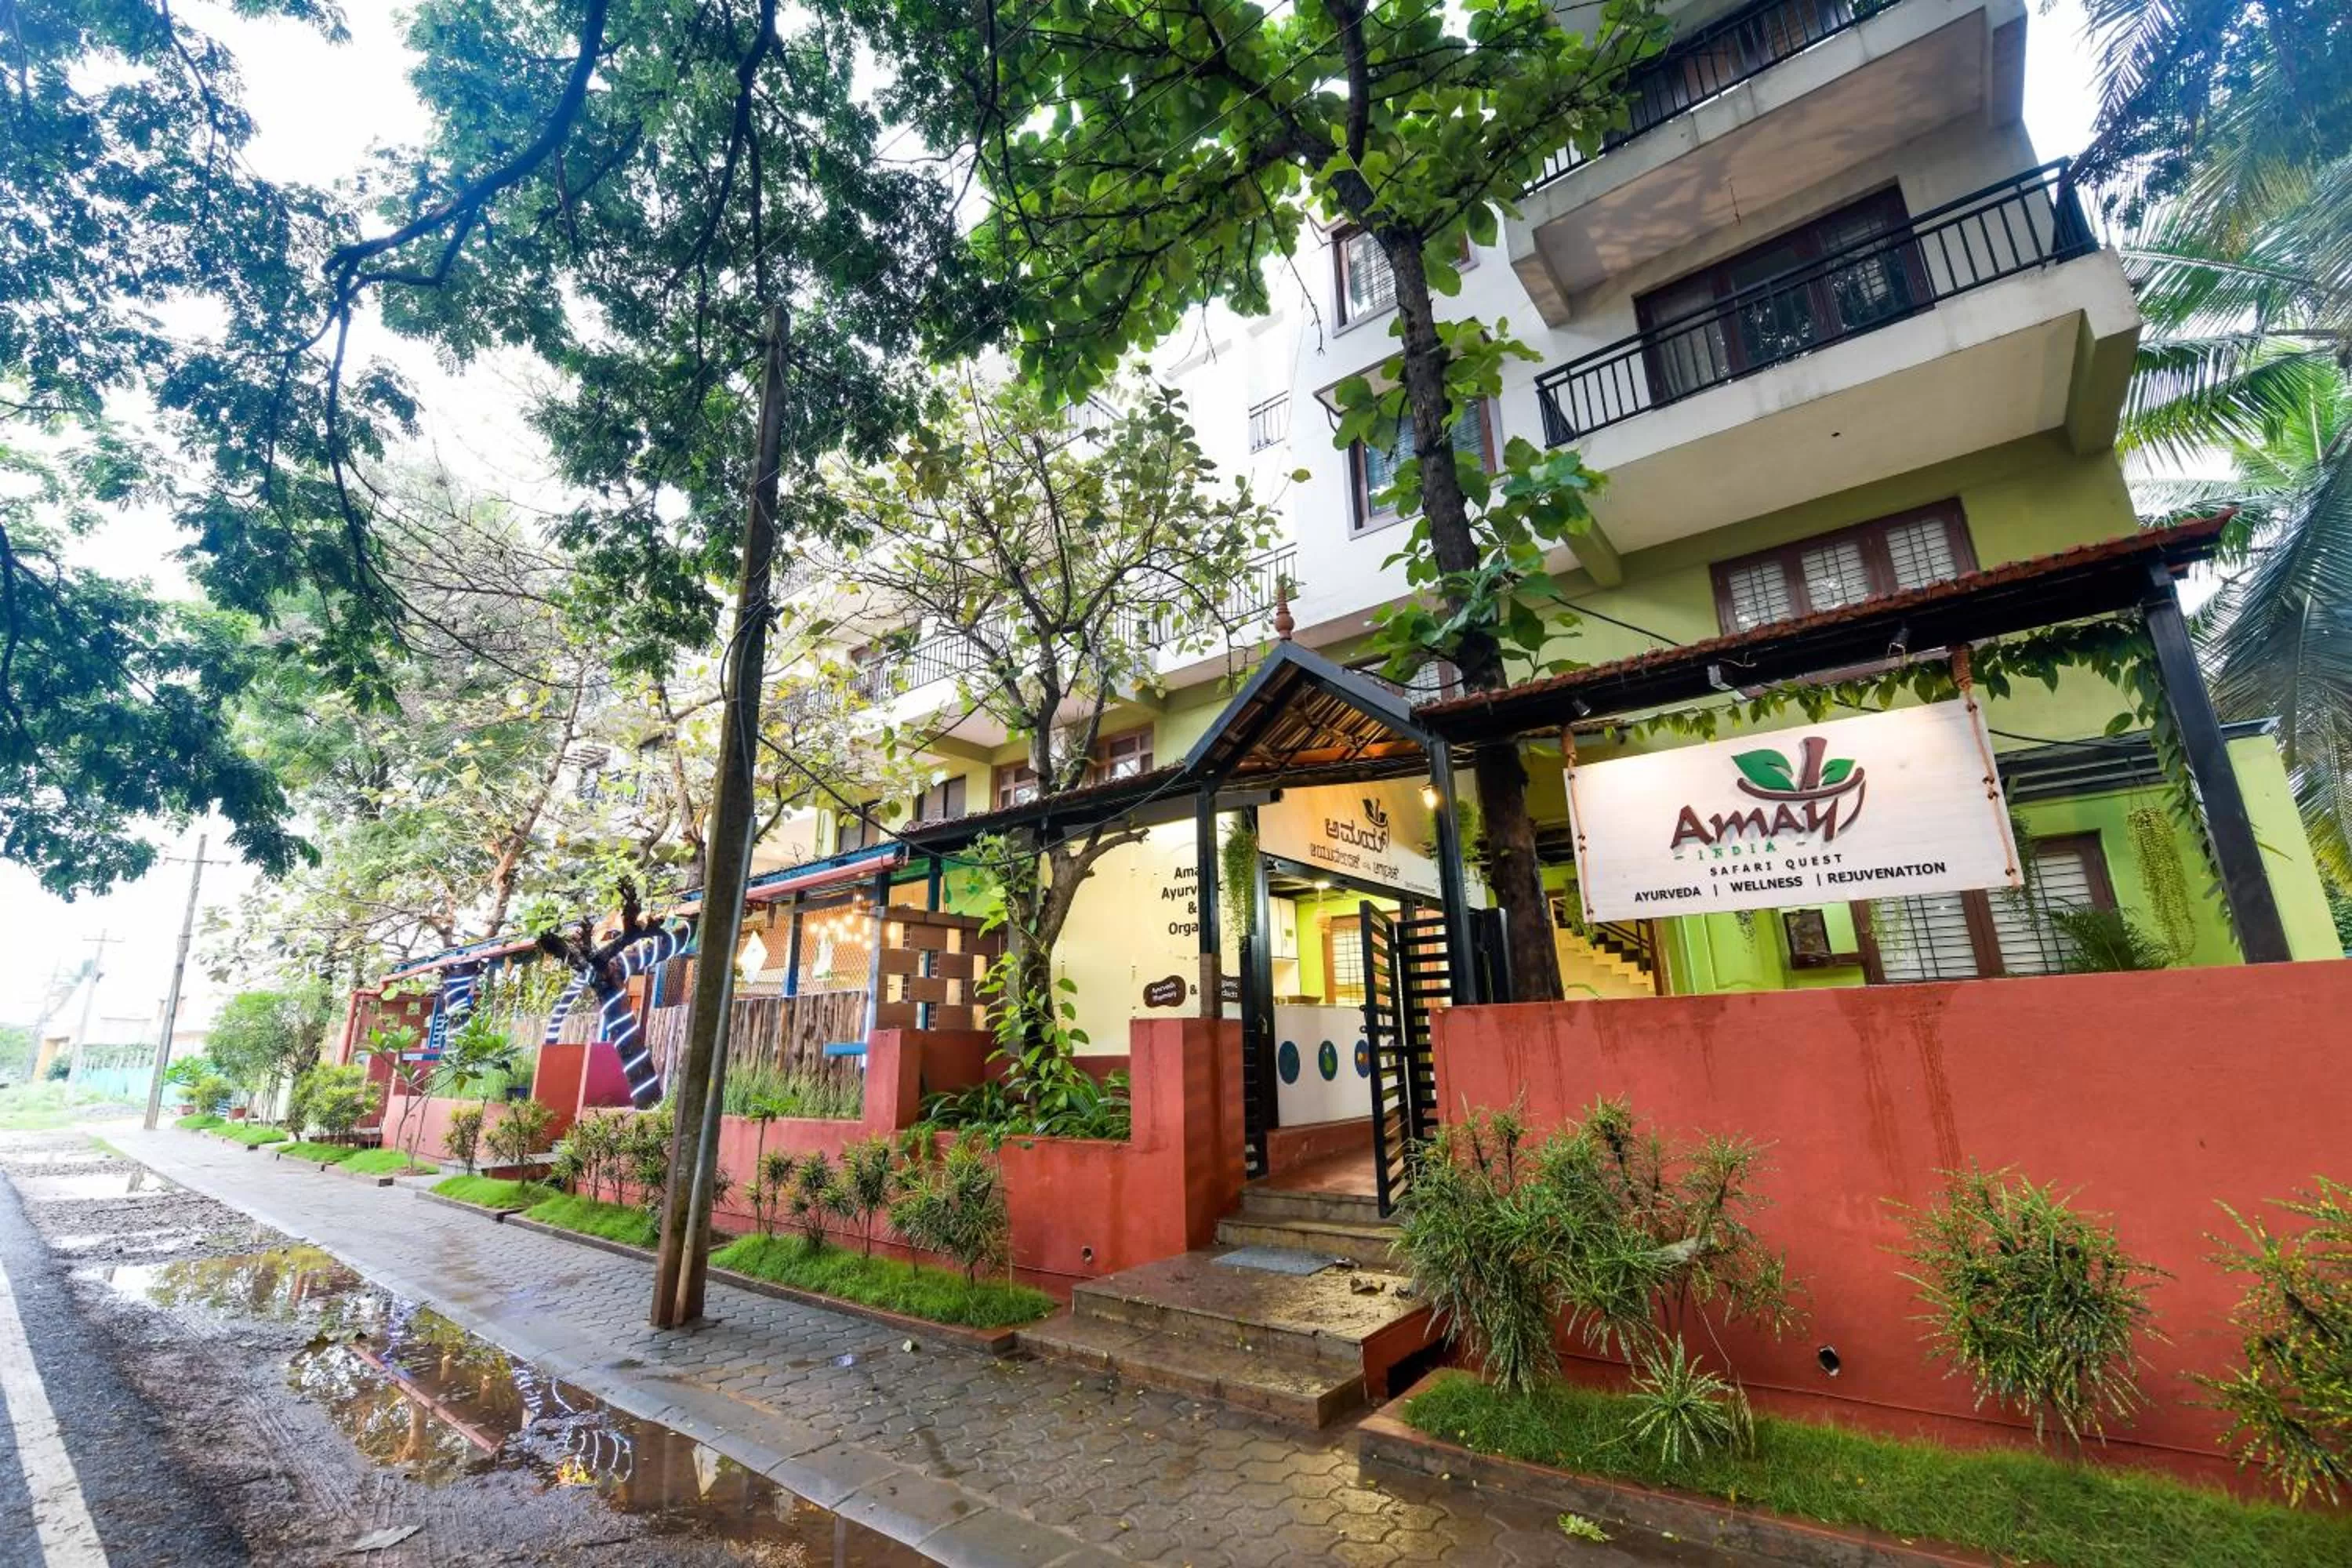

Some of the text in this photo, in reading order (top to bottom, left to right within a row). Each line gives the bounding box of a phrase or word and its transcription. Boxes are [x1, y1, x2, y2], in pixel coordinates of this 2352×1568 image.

[1697, 841, 1777, 860] INDIA
[1710, 854, 1842, 877] SAFARI QUEST
[1635, 886, 1701, 902] AYURVEDA
[1730, 876, 1802, 892] WELLNESS
[1828, 862, 1946, 884] REJUVENATION
[1188, 901, 1197, 914] &
